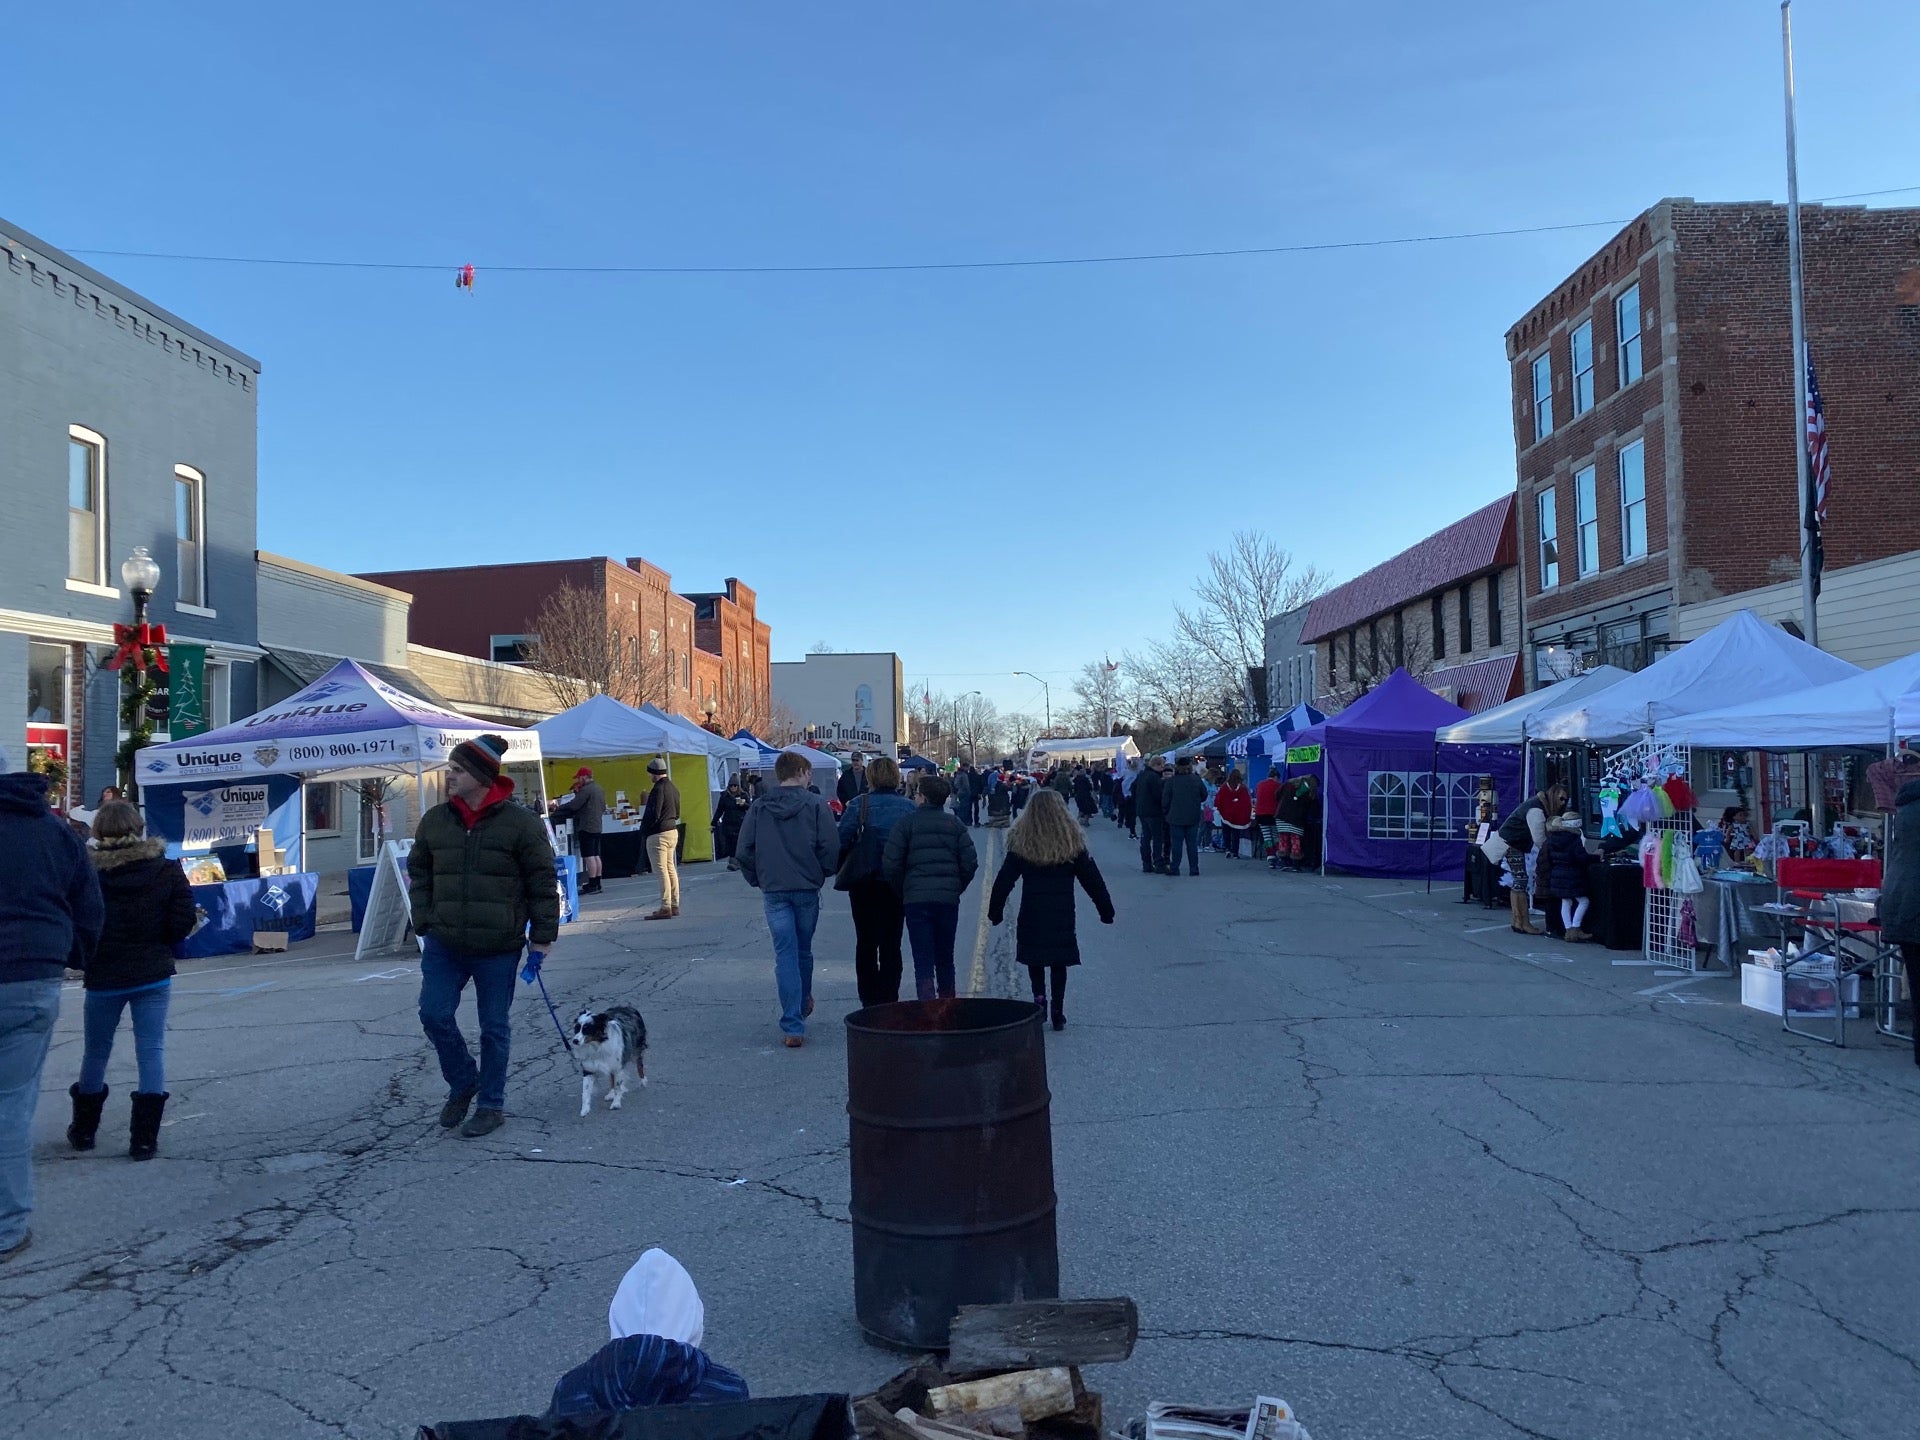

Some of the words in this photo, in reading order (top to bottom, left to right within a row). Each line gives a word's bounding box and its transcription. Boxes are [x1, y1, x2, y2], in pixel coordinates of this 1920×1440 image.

[244, 703, 368, 728] Unique
[787, 724, 833, 743] ortille
[832, 721, 882, 745] Indiana
[176, 751, 242, 766] Unique
[289, 745, 324, 762] (800)
[330, 739, 395, 757] 800-1971
[220, 787, 264, 804] Unique
[219, 824, 259, 841] 800-19
